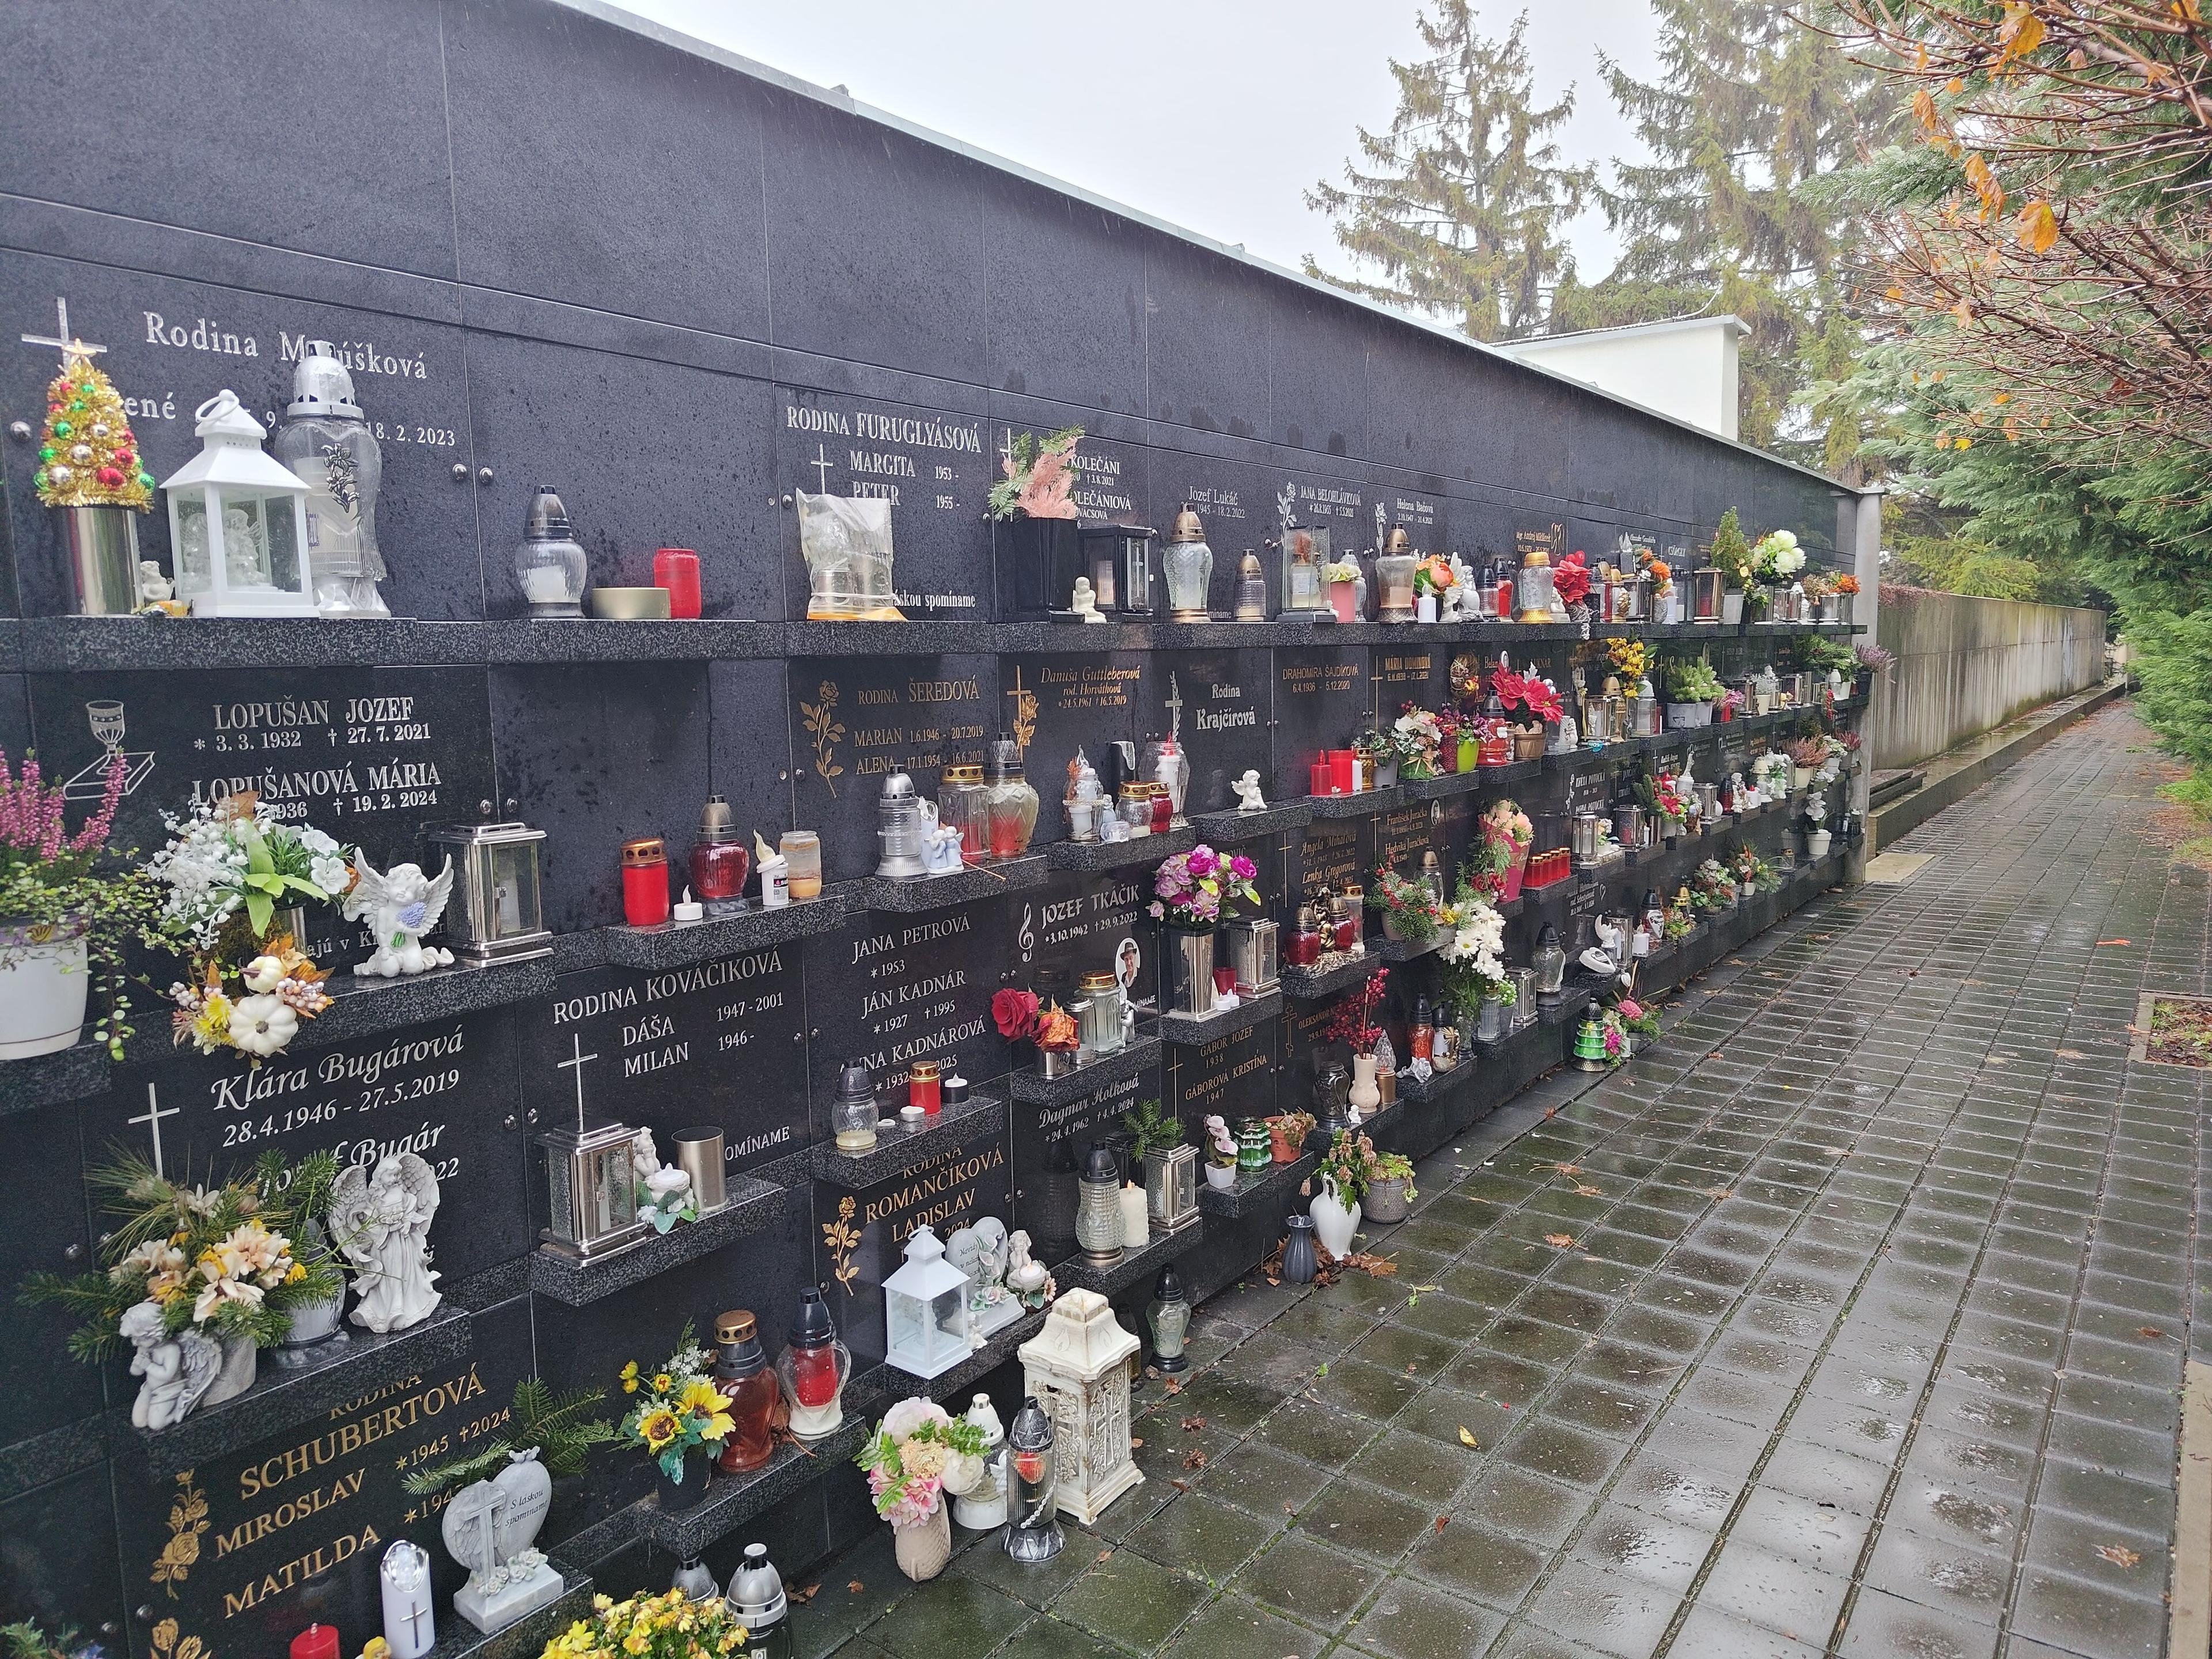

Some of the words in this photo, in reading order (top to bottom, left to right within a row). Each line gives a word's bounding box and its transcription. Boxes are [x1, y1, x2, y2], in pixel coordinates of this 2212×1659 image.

[143, 310, 259, 357] Rodina
[279, 331, 427, 379] Múšková
[415, 426, 456, 446] 2023
[786, 405, 851, 436] RODINA
[855, 411, 983, 454] FURUGLYÁSOVÁ
[849, 449, 916, 478] MARGITA
[934, 465, 953, 481] 1953
[851, 480, 902, 507] PETER
[935, 494, 954, 510] 1955
[1074, 489, 1132, 511] LEČÁNIOVÁ
[1188, 485, 1211, 503] Jozef
[1213, 488, 1239, 506] Lukáč
[1300, 485, 1316, 500] JANA
[1317, 487, 1362, 506] BELOHLÁVKOVÁ
[1396, 497, 1415, 511] Helena
[894, 589, 922, 608] áskou
[924, 589, 976, 612] spomíname
[1209, 608, 1232, 619] míname
[1040, 666, 1078, 684] Danuša
[1082, 664, 1141, 682] Guttleberová
[1282, 665, 1323, 680] DRAHOMÍRA
[1324, 663, 1359, 678] ŠAJDÍKOVÁ
[858, 689, 899, 706] RODINA
[908, 674, 980, 704] ŠEREDOVÁ
[1063, 684, 1078, 696] rod.
[1080, 682, 1122, 696] Horváthová
[1211, 683, 1241, 699] Rodina
[212, 694, 330, 730] LOPUŠAN
[344, 696, 415, 724] JOZEF
[1196, 706, 1256, 733] Krajčírová
[260, 730, 302, 749] 1932
[393, 722, 432, 741] 2021
[853, 727, 903, 748] MARIAN
[910, 728, 940, 744] 1.6.1946
[950, 724, 984, 740] 20.7.2019
[855, 755, 895, 775] ALENA
[906, 753, 941, 770] 17.1.1954
[951, 749, 984, 765] 16.6.2021
[191, 760, 359, 807] LOPUŠANOVÁ
[367, 756, 443, 791] MÁRIA
[276, 801, 308, 820] 936
[399, 789, 438, 808] 2024
[1301, 866, 1323, 884] Lenka
[1041, 897, 1084, 930] JOZEF
[1090, 882, 1140, 912] TKÁČIK
[851, 933, 896, 965] JANA
[902, 911, 971, 947] PETROVÁ
[552, 985, 638, 1025] RODINA
[645, 943, 784, 1002] KOVÁČIKOVÁ
[861, 990, 893, 1020] JÁN
[897, 968, 967, 1004] KADNÁR
[622, 1013, 676, 1047] DÁŠA
[715, 1001, 745, 1023] 1947
[755, 991, 785, 1013] 2001
[1231, 1025, 1253, 1044] JOZEF
[623, 1041, 690, 1079] MILAN
[717, 1029, 748, 1052] 1946
[891, 1014, 987, 1063] KADNÁROVÁ
[210, 1065, 310, 1112] Klára
[318, 1024, 467, 1085] Bugárová
[1185, 1068, 1229, 1101] GÁBOROVÁ
[1232, 1048, 1268, 1079] KRISTÍNA
[1206, 1052, 1224, 1069] 1938
[222, 1099, 338, 1149] 28.4.1946
[359, 1068, 461, 1114] 27.5.2019
[1038, 1097, 1090, 1130] Dagmar
[1091, 1071, 1141, 1106] Holková
[1117, 1096, 1135, 1113] 2024
[1206, 1088, 1225, 1105] 1947
[724, 1125, 791, 1162] OMÍNAME
[865, 1141, 1005, 1225] ROMANČÍKOVÁ
[892, 1187, 976, 1243] LADISLAV
[239, 1362, 487, 1501] SCHUBERTOVÁ
[214, 1467, 367, 1559] MIROSLAV
[510, 1498, 517, 1510] S
[222, 1523, 382, 1619] MATILDA
[403, 1483, 464, 1525] 194
